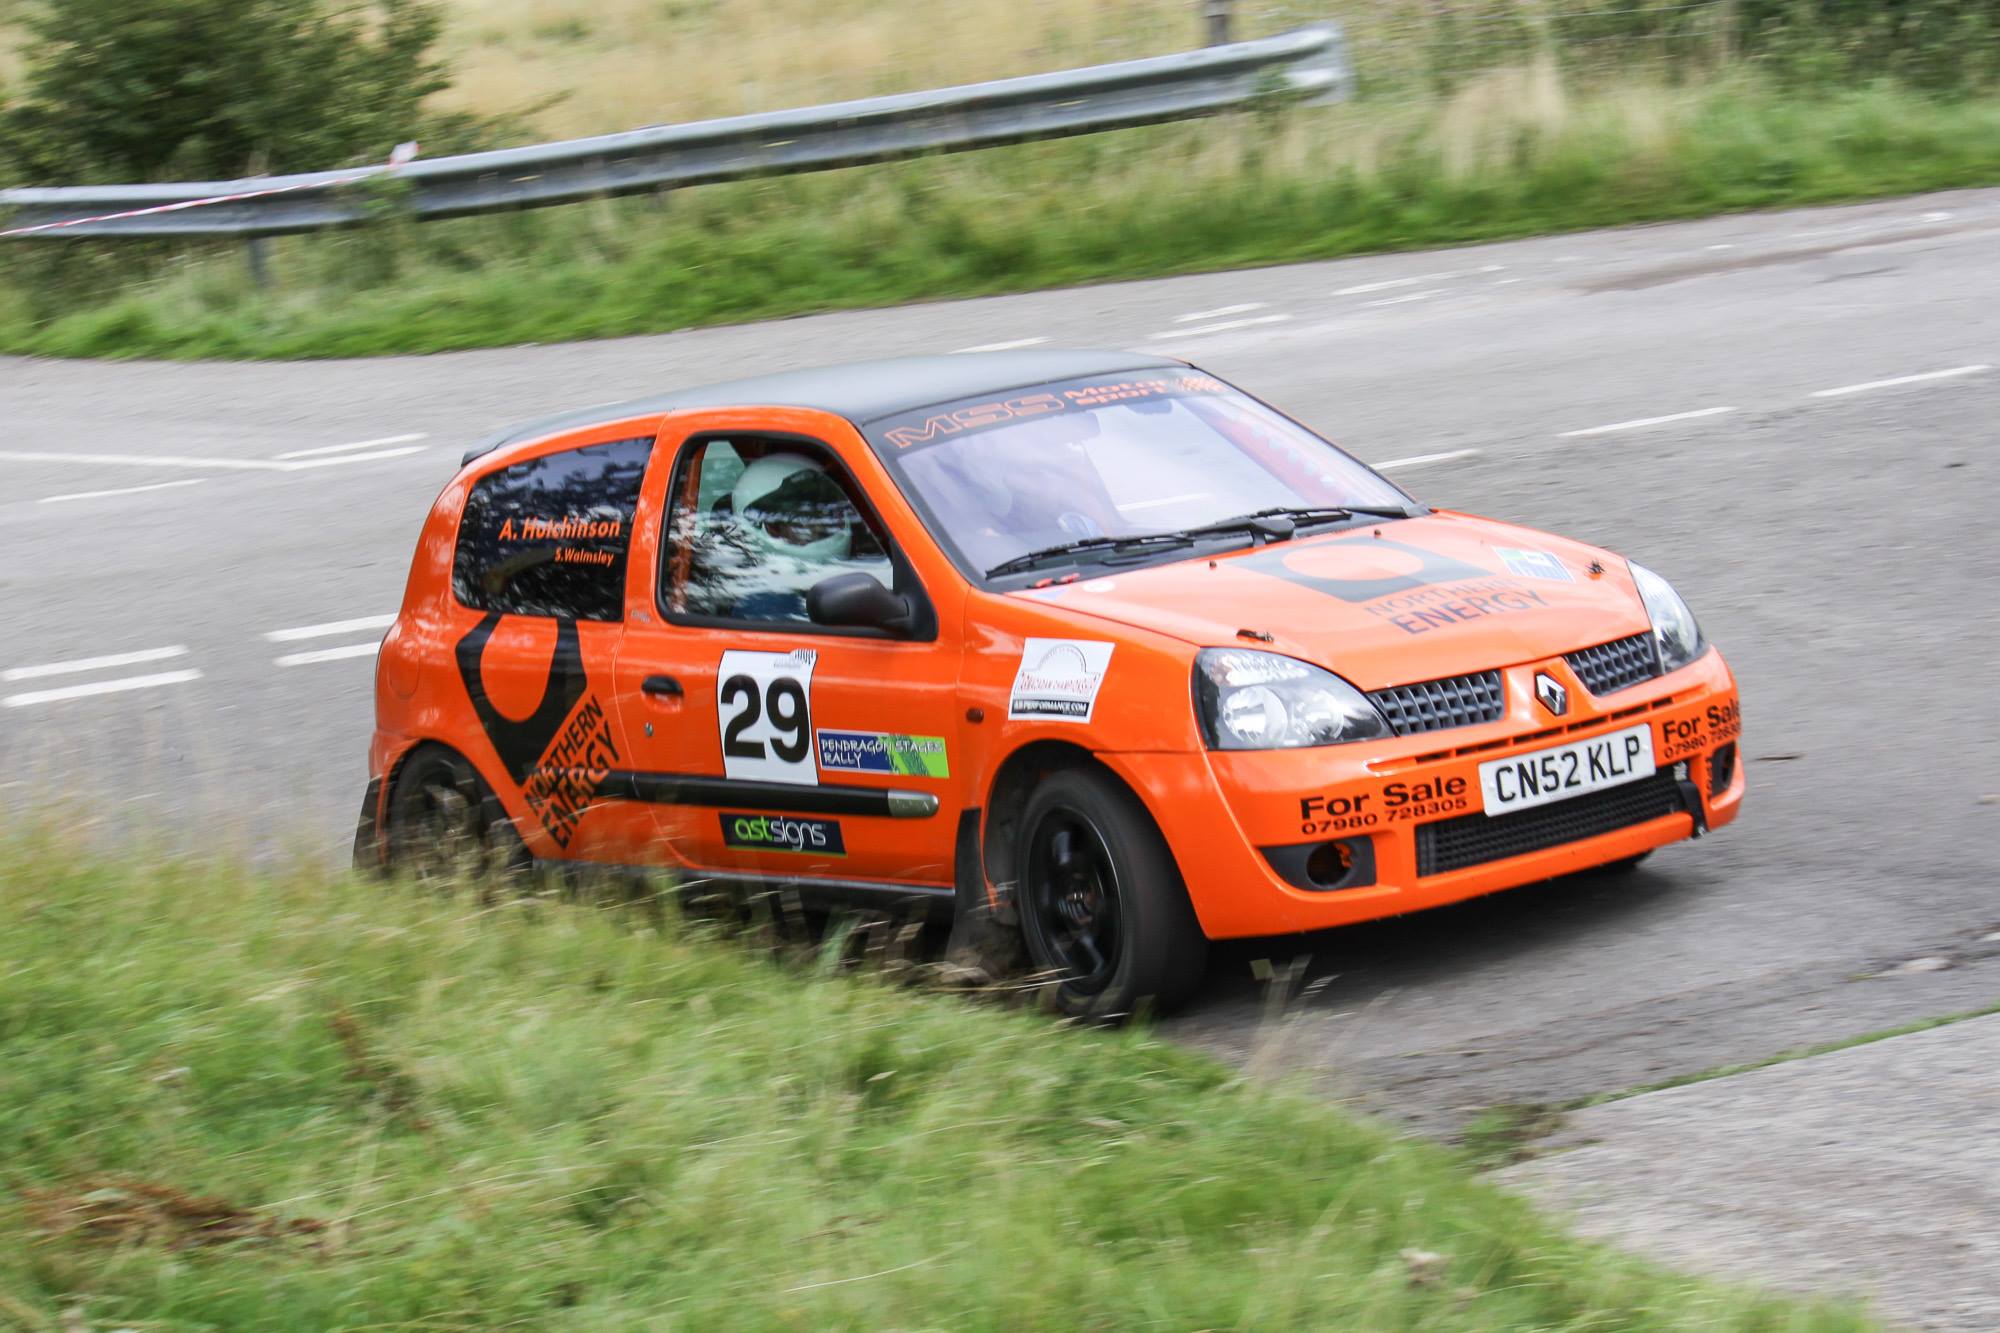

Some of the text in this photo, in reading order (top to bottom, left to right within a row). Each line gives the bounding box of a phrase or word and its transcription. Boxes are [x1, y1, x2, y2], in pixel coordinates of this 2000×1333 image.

[884, 394, 1064, 448] MSS
[498, 514, 621, 541] A. Hutchinson
[1388, 588, 1549, 634] ENERGY
[720, 674, 811, 763] 29
[1663, 716, 1701, 743] For
[821, 739, 892, 755] PENDRAGON
[824, 751, 861, 769] RALLY
[541, 720, 620, 849] ENERGY
[1495, 735, 1640, 803] CN52 KLP
[1301, 777, 1467, 820] For Sale
[1302, 798, 1467, 835] 07980 728305
